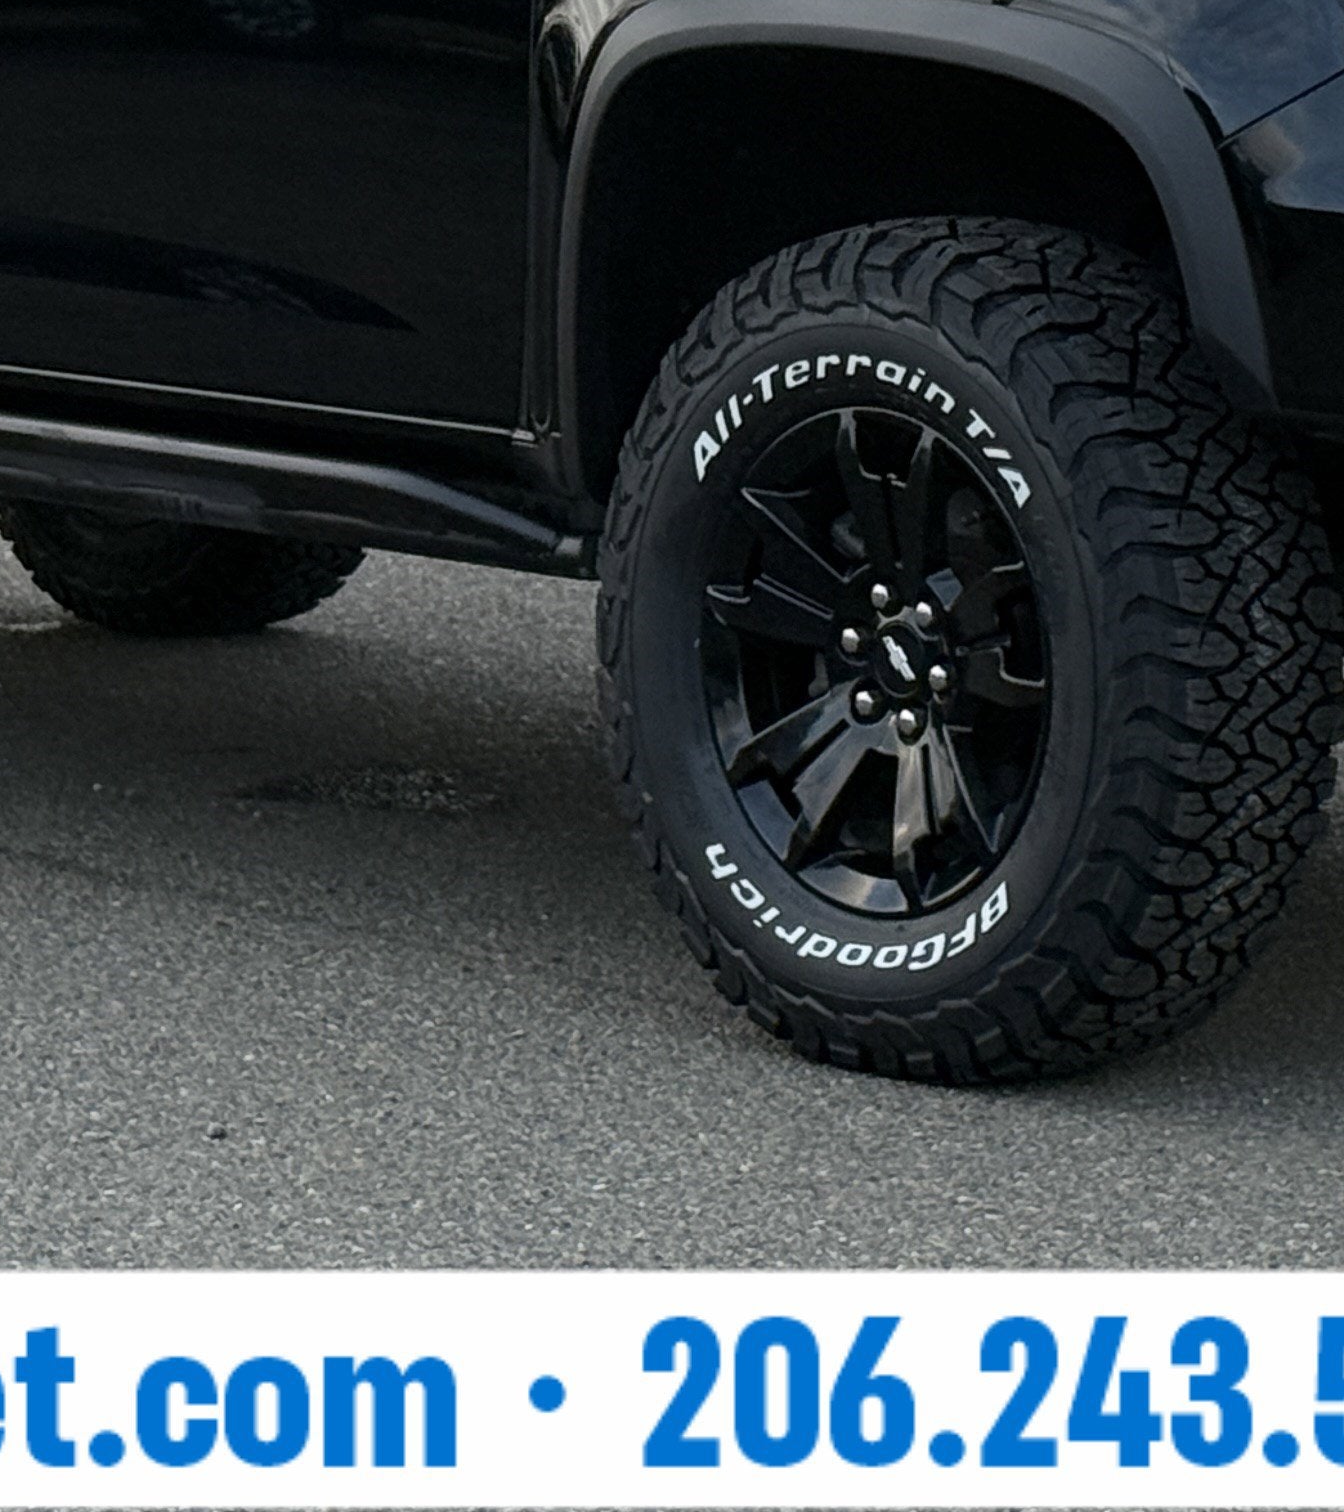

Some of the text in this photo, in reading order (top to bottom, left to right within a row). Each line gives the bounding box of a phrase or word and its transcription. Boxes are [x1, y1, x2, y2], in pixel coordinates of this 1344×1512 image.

[693, 353, 1032, 509] All-Terrain T/A
[704, 842, 1009, 971] BFGoodrich
